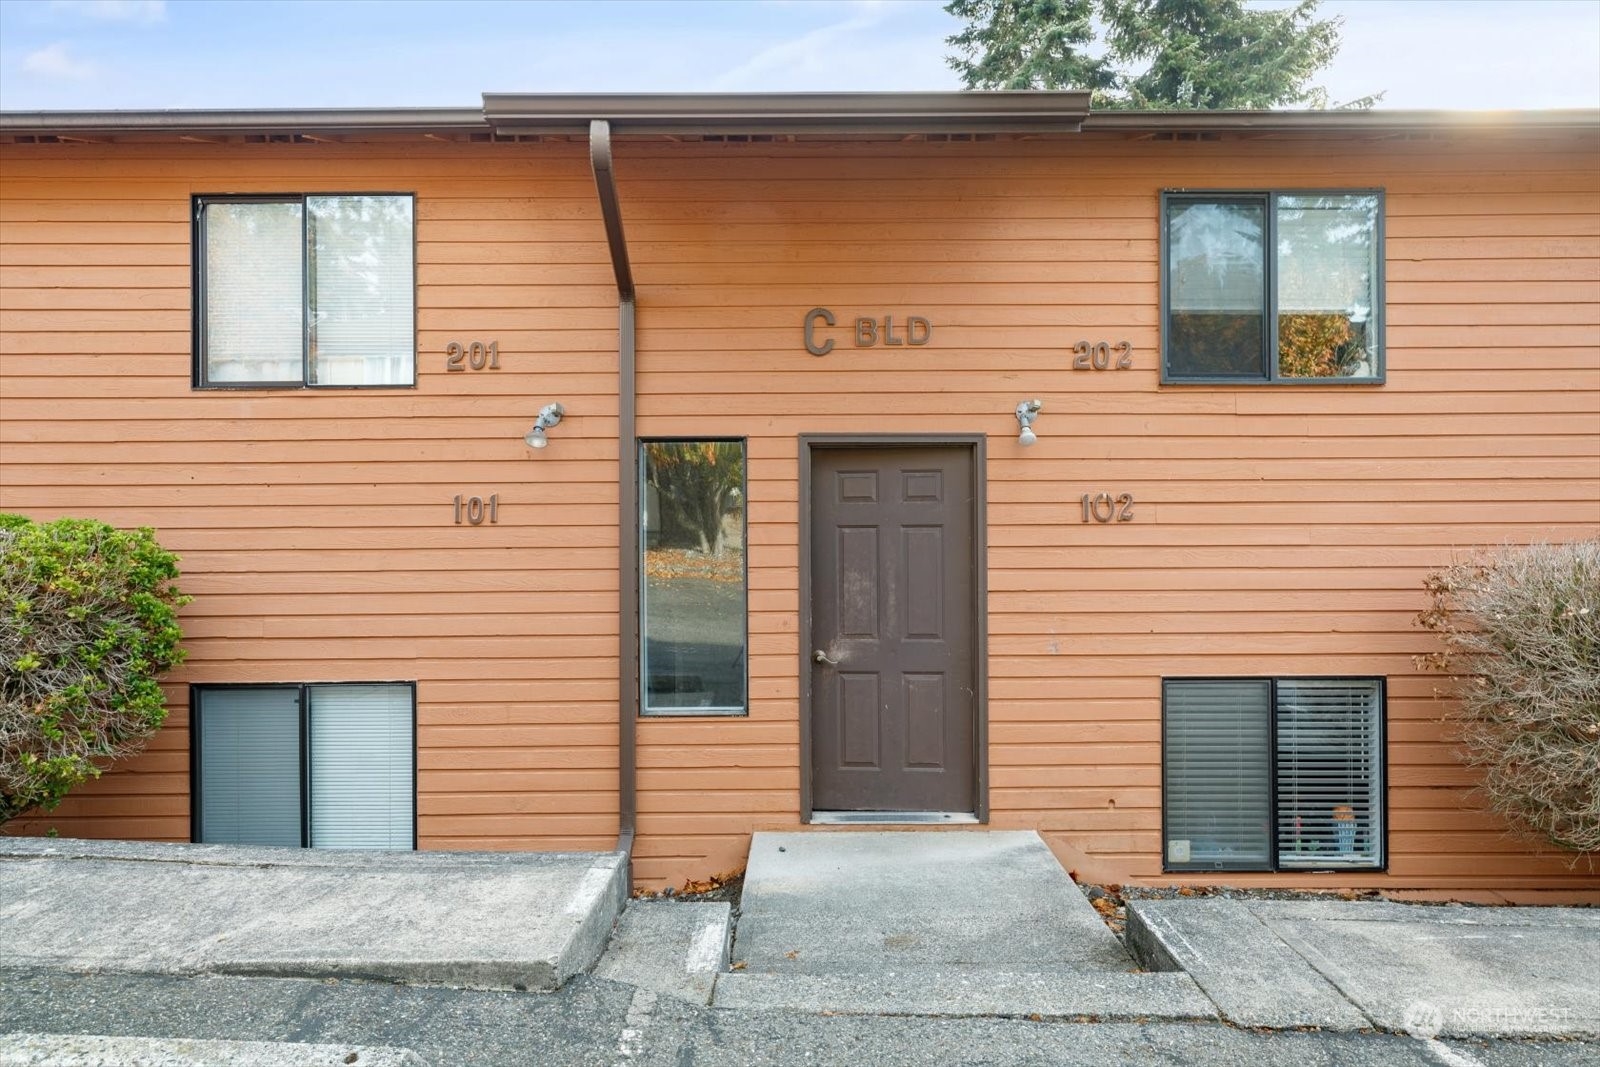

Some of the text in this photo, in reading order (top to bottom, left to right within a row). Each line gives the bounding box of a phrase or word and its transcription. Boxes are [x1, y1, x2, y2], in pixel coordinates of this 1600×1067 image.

[804, 307, 932, 357] C BLD
[447, 340, 501, 371] 201
[1073, 340, 1133, 370] 202
[453, 493, 499, 526] 101
[1081, 492, 1134, 523] 102
